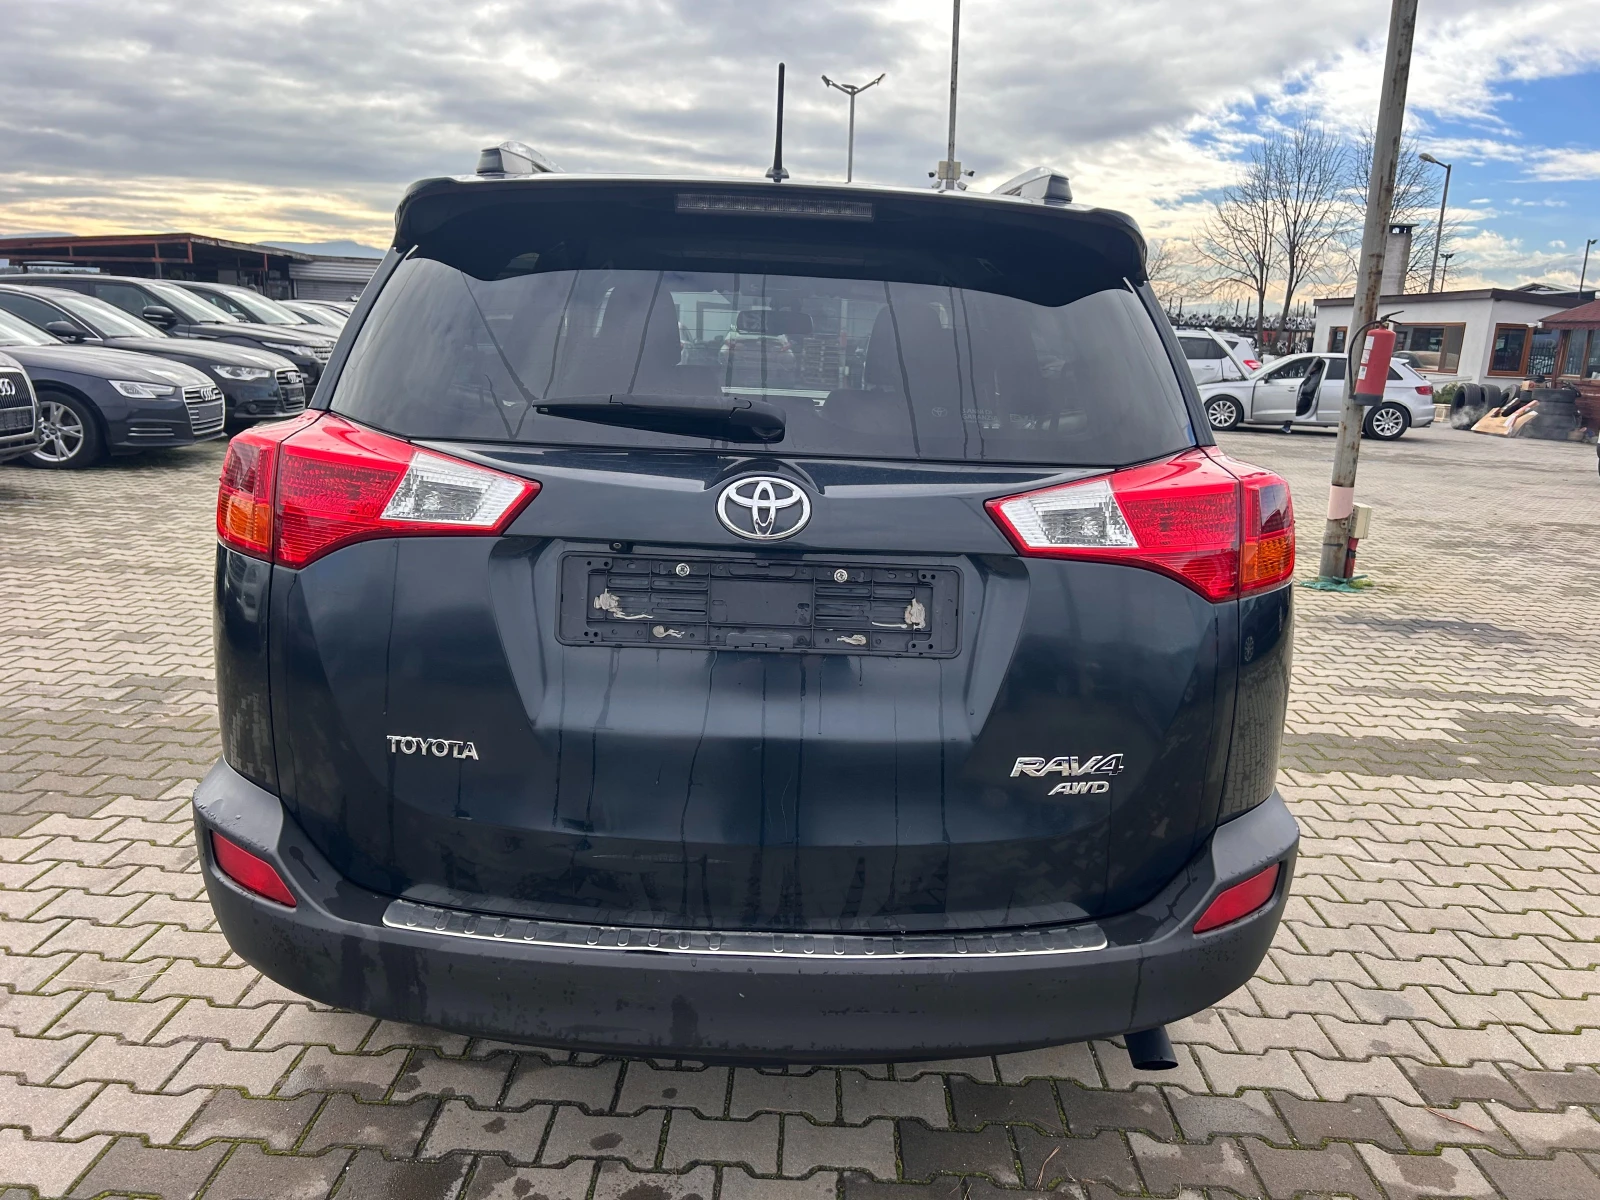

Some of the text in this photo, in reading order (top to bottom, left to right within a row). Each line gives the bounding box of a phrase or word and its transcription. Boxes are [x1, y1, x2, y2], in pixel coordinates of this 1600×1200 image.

[386, 735, 479, 760] TOYOTA
[1010, 753, 1124, 777] RAV4
[1047, 781, 1109, 796] AWD
